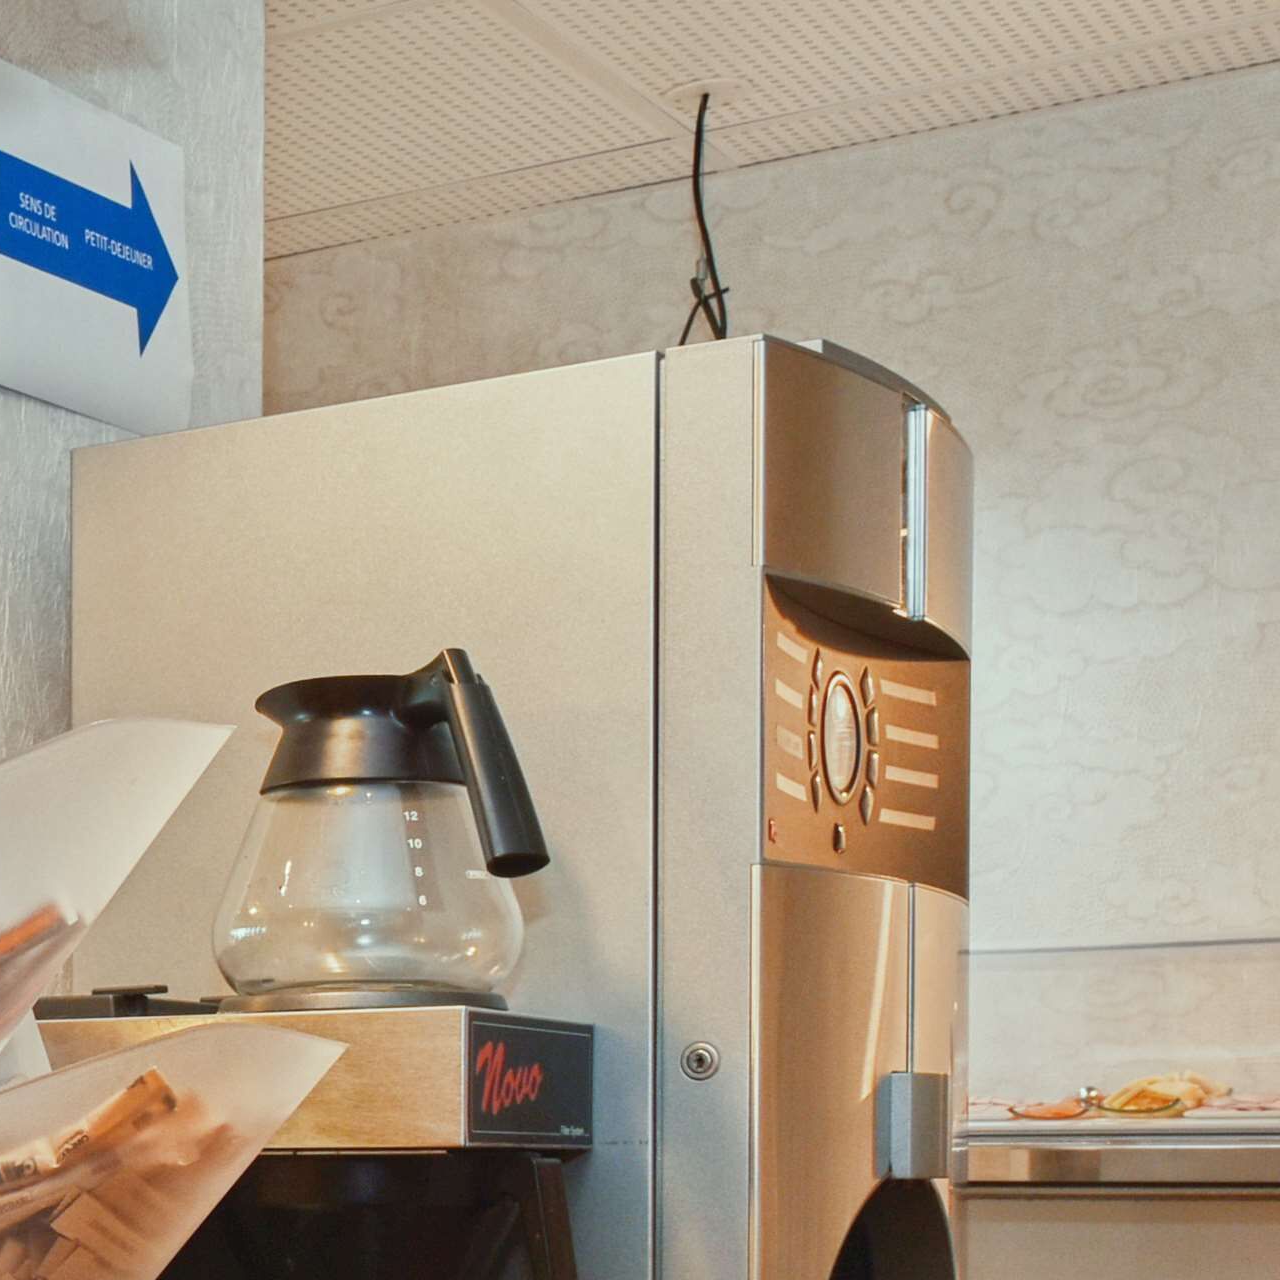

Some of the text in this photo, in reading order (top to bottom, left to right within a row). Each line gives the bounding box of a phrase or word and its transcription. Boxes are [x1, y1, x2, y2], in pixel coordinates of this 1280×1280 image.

[19, 192, 57, 221] SENS DE
[9, 212, 69, 250] CIRCULATION
[84, 229, 153, 270] PETIT-DEJEUNER
[403, 811, 418, 821] 12
[407, 838, 422, 849] 10
[476, 1040, 543, 1116] Novo
